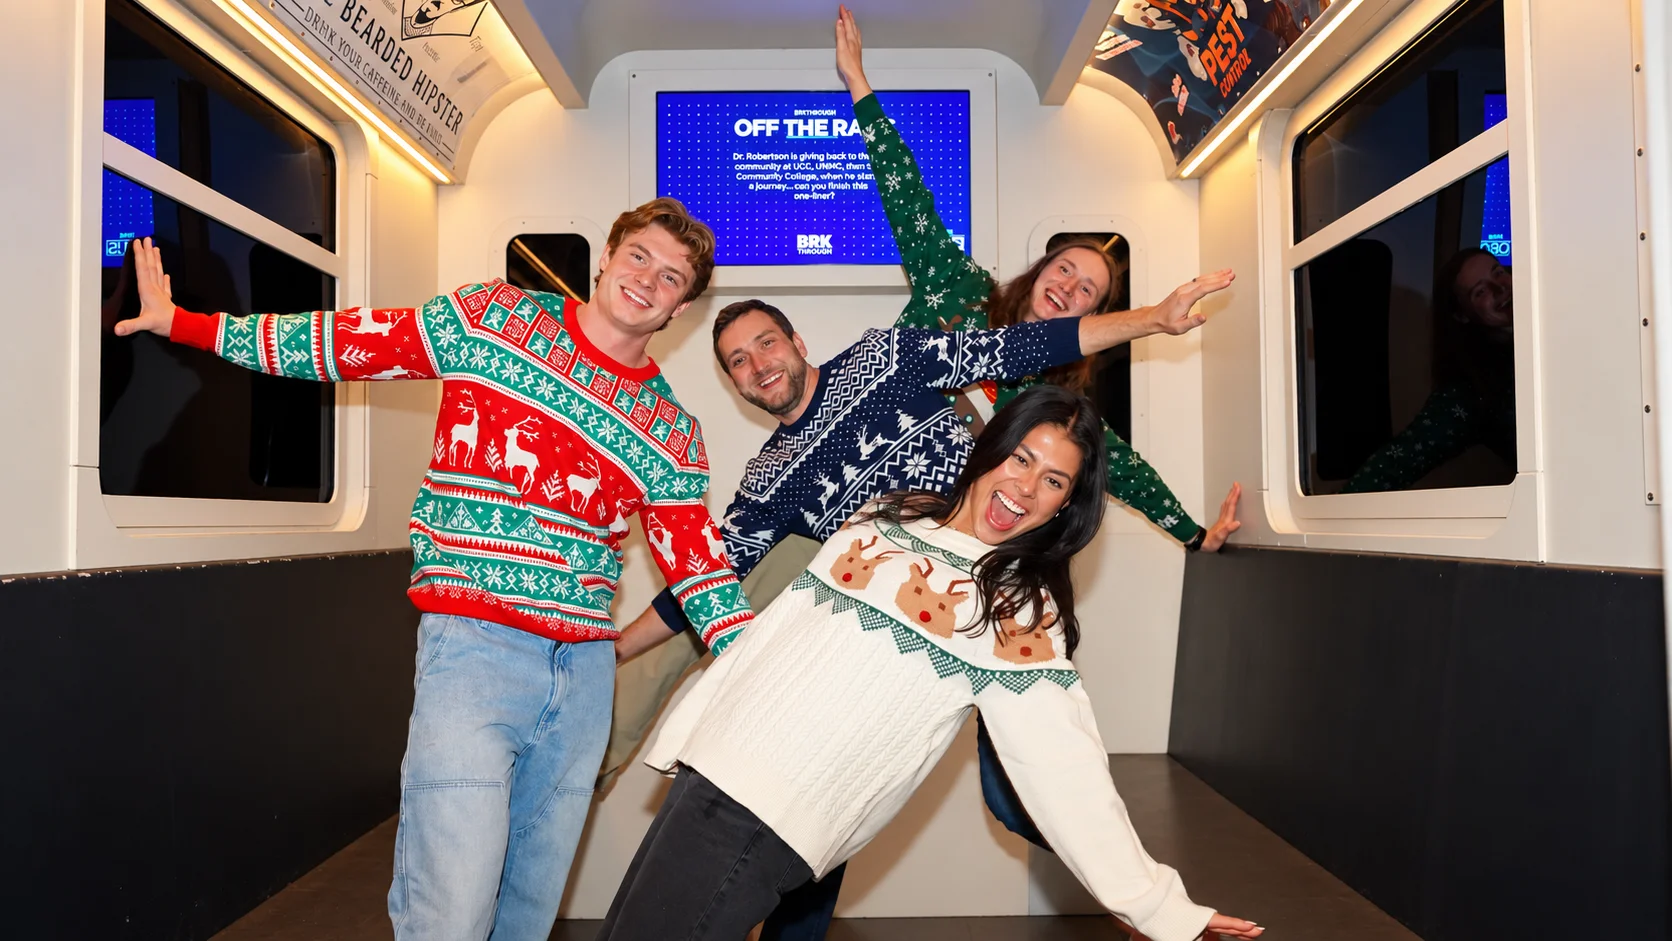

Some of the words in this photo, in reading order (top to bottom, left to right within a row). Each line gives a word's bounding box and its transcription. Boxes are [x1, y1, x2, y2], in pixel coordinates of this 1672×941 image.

[1200, 3, 1245, 86] PEST
[340, 0, 413, 81] BEARDED
[412, 69, 463, 135] HIPSTER
[1219, 48, 1252, 98] CONTROL
[337, 37, 363, 70] YOUR
[362, 62, 402, 106] CAFFEINE
[401, 99, 417, 120] AND
[734, 118, 780, 137] OFF
[783, 119, 828, 137] THE
[732, 152, 745, 160] Dr.
[746, 152, 789, 160] Robertson
[790, 152, 798, 160] is
[799, 152, 825, 162] giving
[826, 152, 847, 160] back
[858, 152, 870, 160] th
[734, 163, 782, 172] community
[793, 163, 815, 171] UCC,
[735, 172, 783, 182] Community
[784, 172, 819, 181] College,
[811, 183, 827, 192] you
[828, 182, 851, 190] finish
[852, 182, 869, 190] this
[793, 192, 835, 200] one-liner?
[797, 234, 833, 249] BRK
